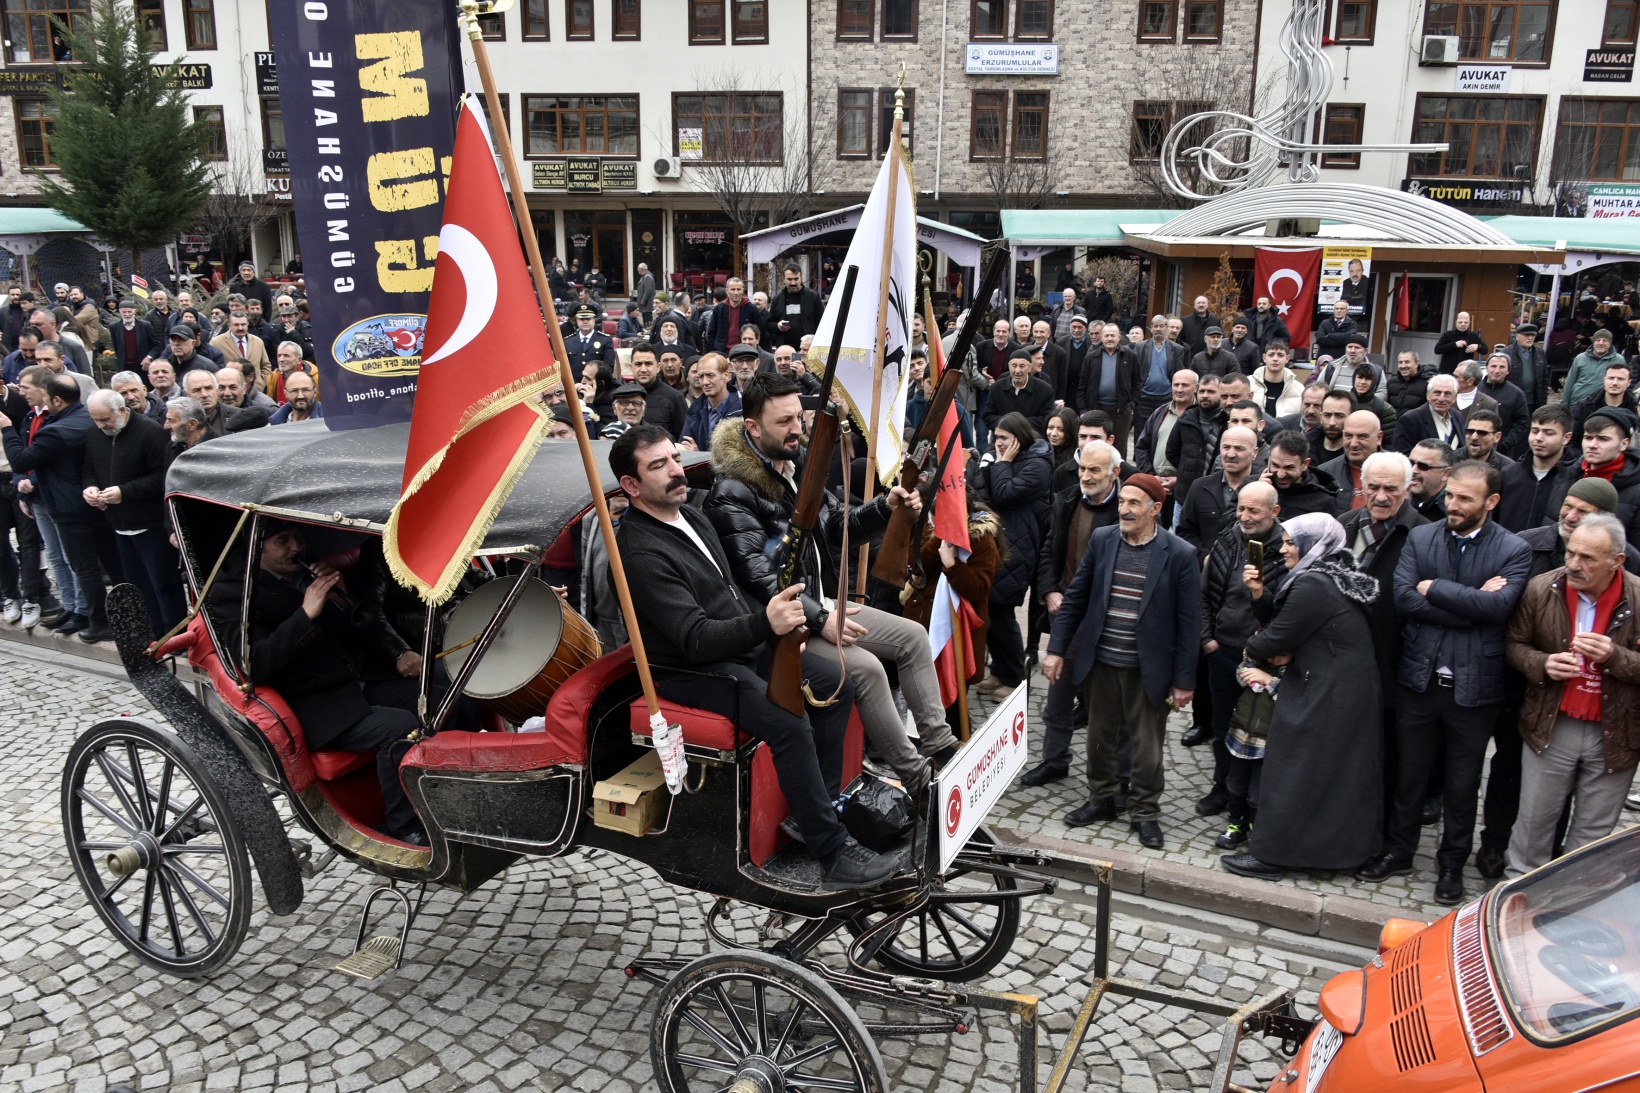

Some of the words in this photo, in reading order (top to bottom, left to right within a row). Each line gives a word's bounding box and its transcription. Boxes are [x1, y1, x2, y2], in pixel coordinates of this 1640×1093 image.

[988, 48, 1036, 57] GÜMÜŞHANE
[1588, 53, 1634, 63] AVUKAT
[1460, 70, 1507, 81] AVUKAT
[182, 78, 205, 88] BALKİ
[1480, 82, 1501, 90] DEMİR
[569, 162, 598, 170] AVUKAT
[1593, 199, 1633, 208] MUHTAR
[790, 214, 848, 239] GÜMÜŞHANE
[966, 728, 1008, 790] GÜMÜŞHANE
[970, 754, 1006, 808] BELEDİYESİ
